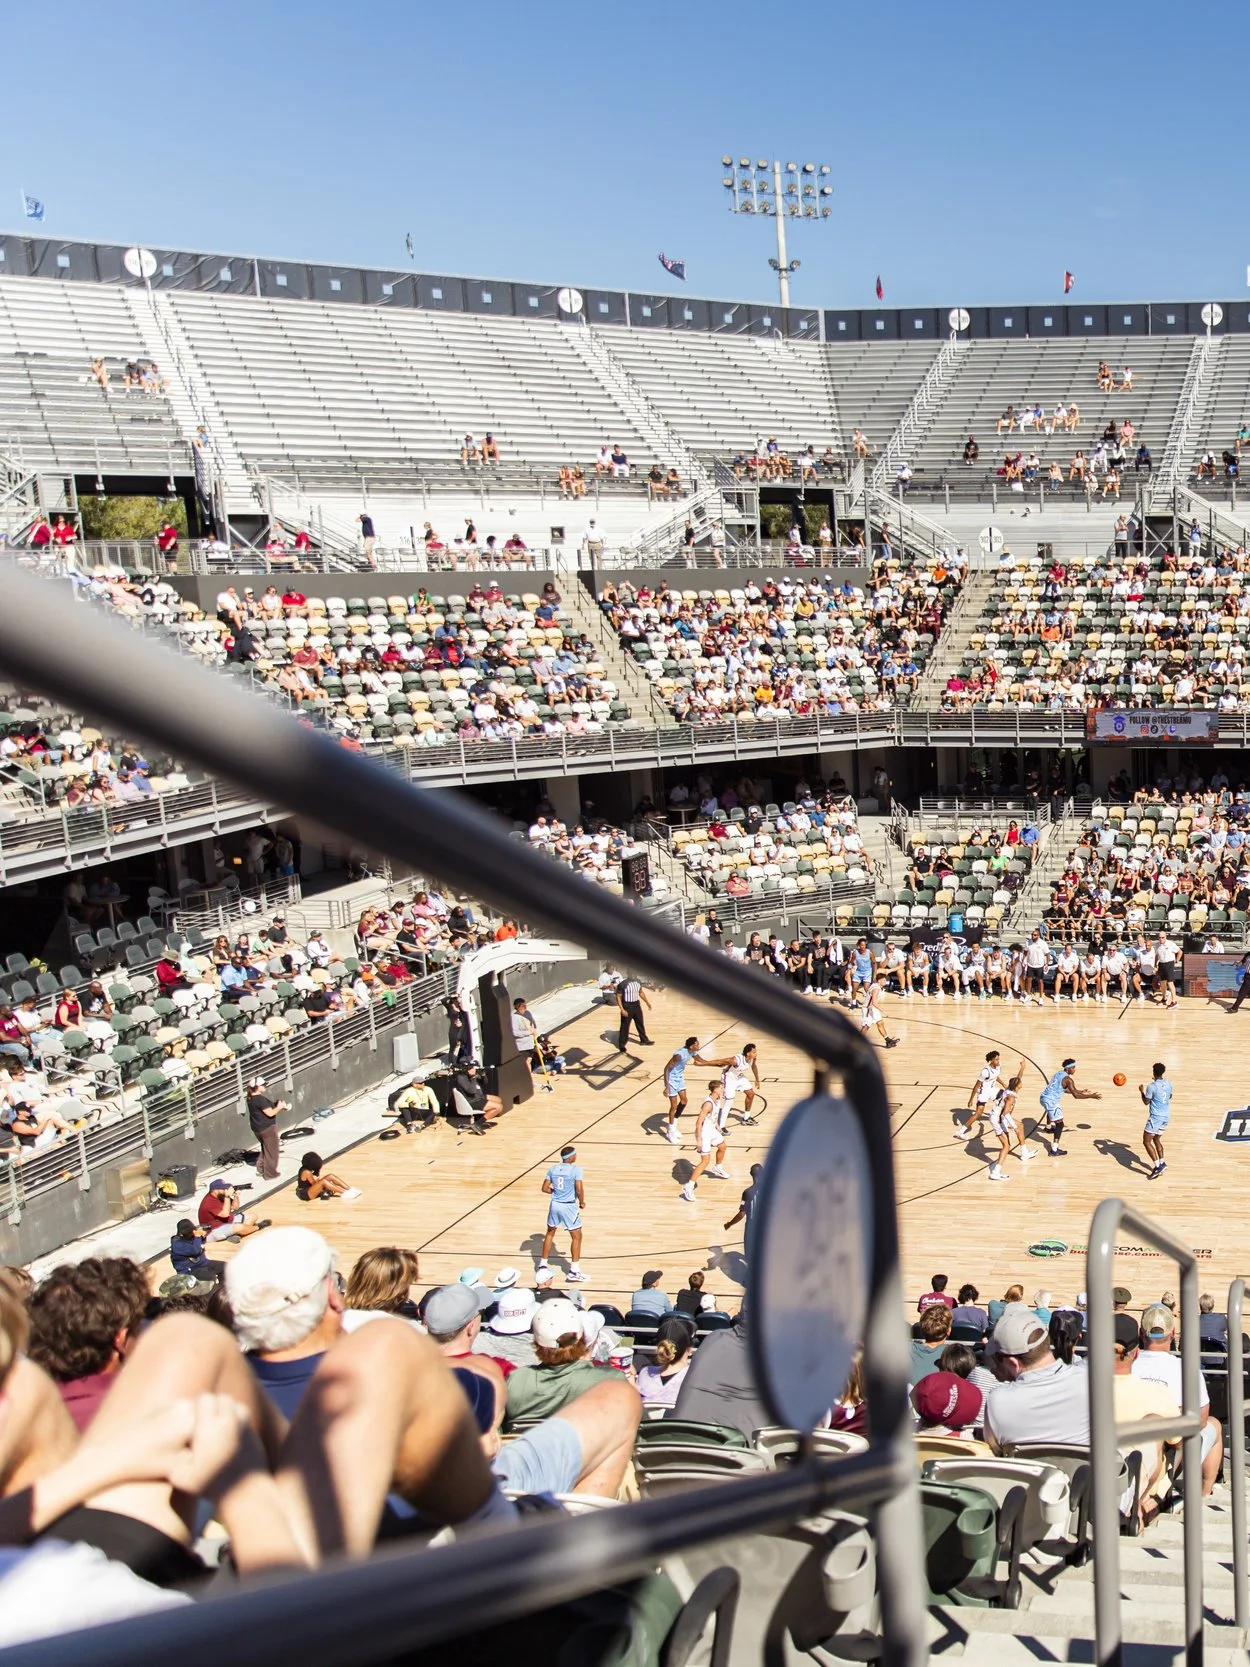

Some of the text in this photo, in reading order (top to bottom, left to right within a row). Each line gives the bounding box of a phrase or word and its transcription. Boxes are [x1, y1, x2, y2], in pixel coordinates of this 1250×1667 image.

[1129, 716, 1192, 725] FOLLOW @THESTREAMU
[557, 1176, 565, 1190] 8
